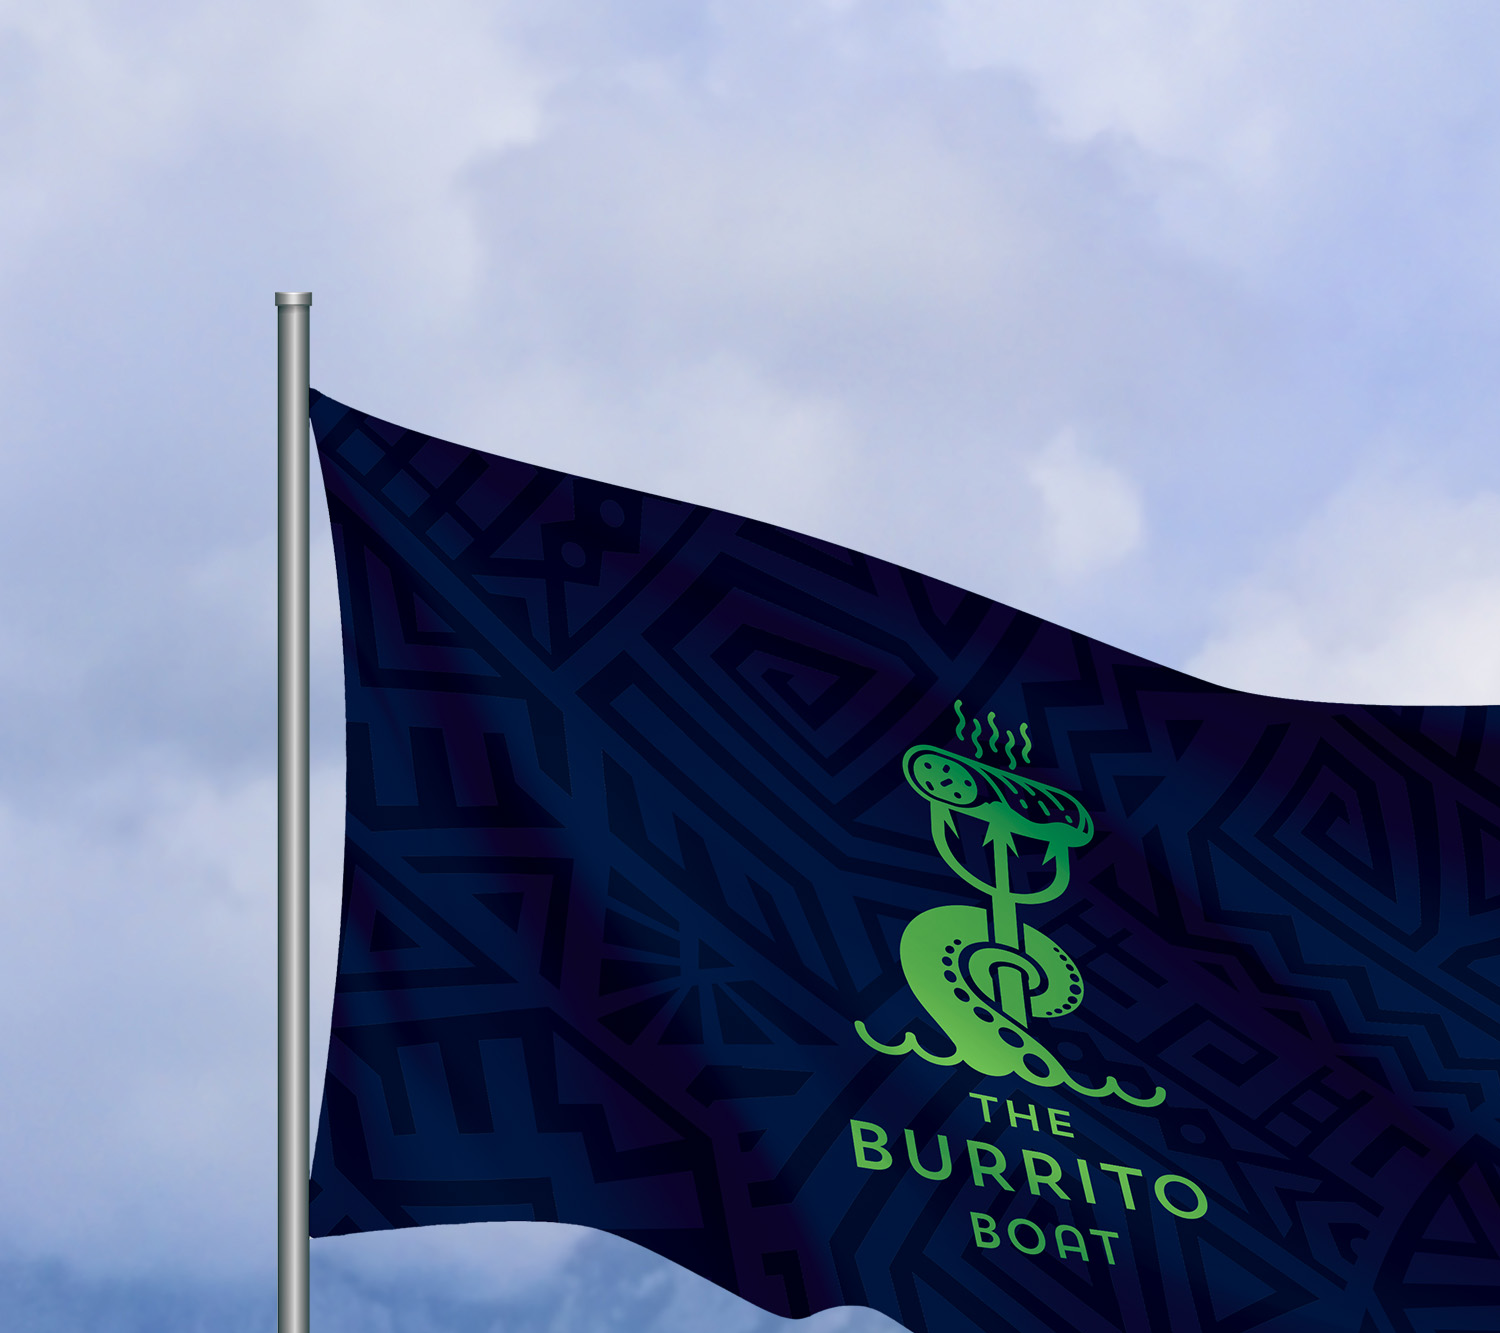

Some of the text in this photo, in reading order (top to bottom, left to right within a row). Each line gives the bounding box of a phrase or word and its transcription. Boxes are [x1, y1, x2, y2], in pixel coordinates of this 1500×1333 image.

[968, 1092, 1075, 1138] THE
[849, 1119, 1208, 1220] BURRITO
[969, 1211, 1119, 1265] BOAT
